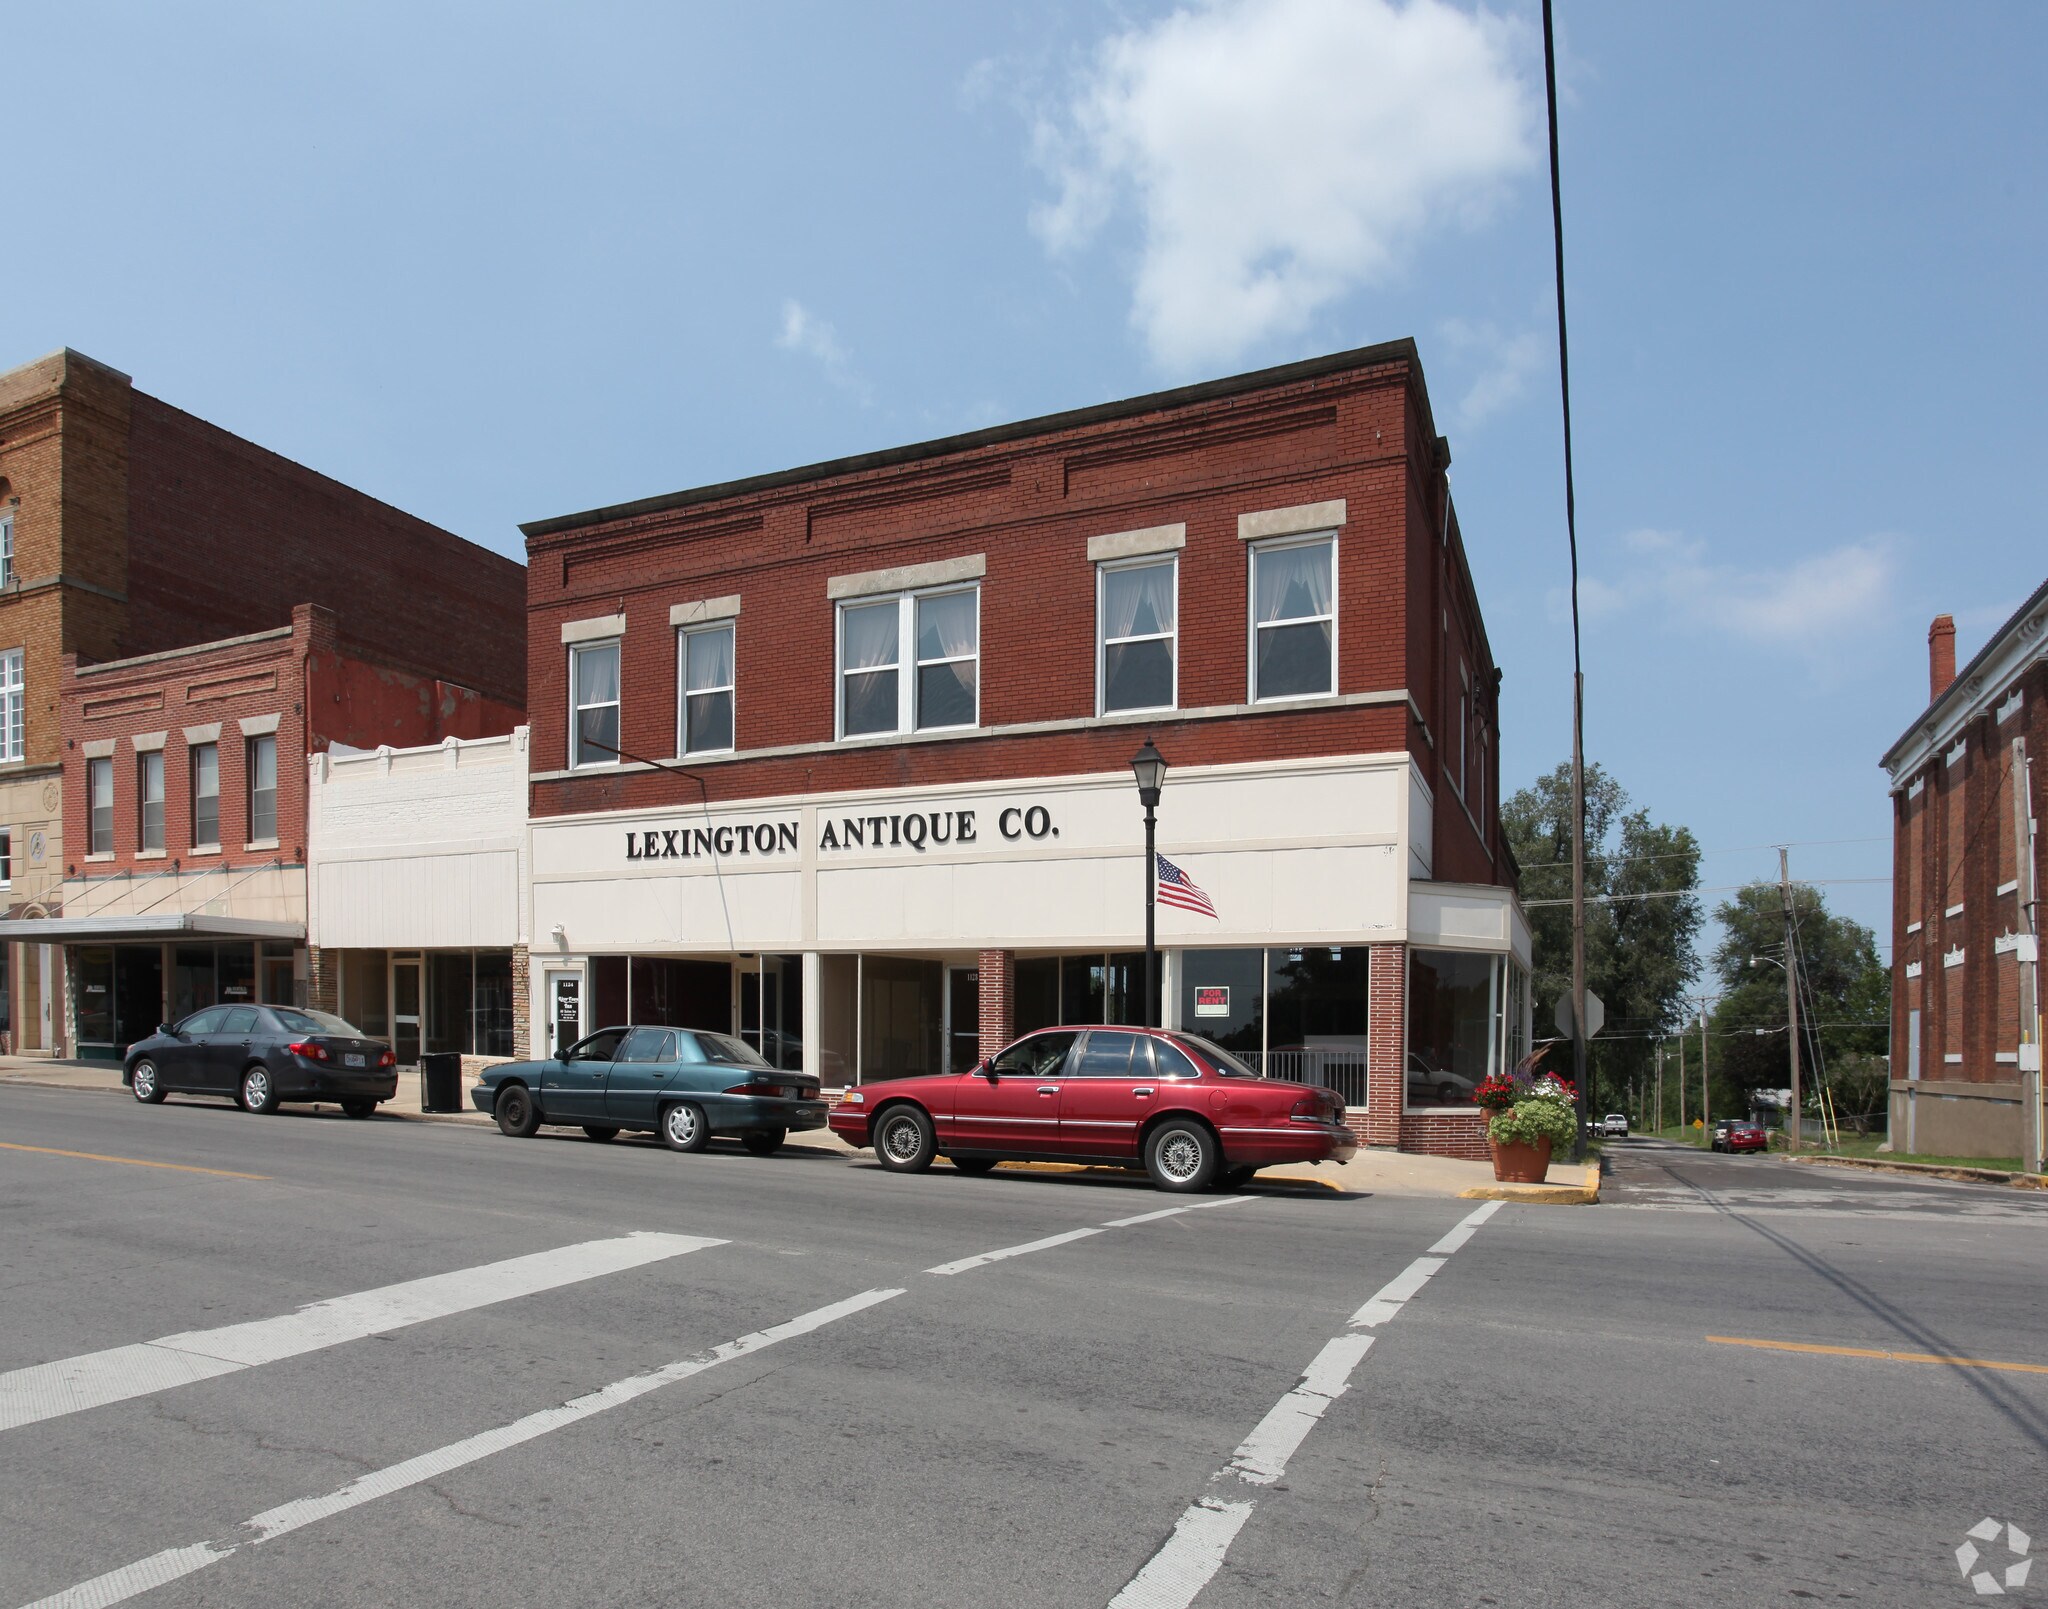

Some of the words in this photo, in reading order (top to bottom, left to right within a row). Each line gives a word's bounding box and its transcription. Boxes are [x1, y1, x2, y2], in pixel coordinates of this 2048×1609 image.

[626, 821, 799, 859] LEXINGTON
[819, 810, 977, 850] ANTIQUE
[999, 805, 1060, 839] CO.
[1203, 989, 1222, 997] FOR
[1198, 997, 1227, 1005] RENT
